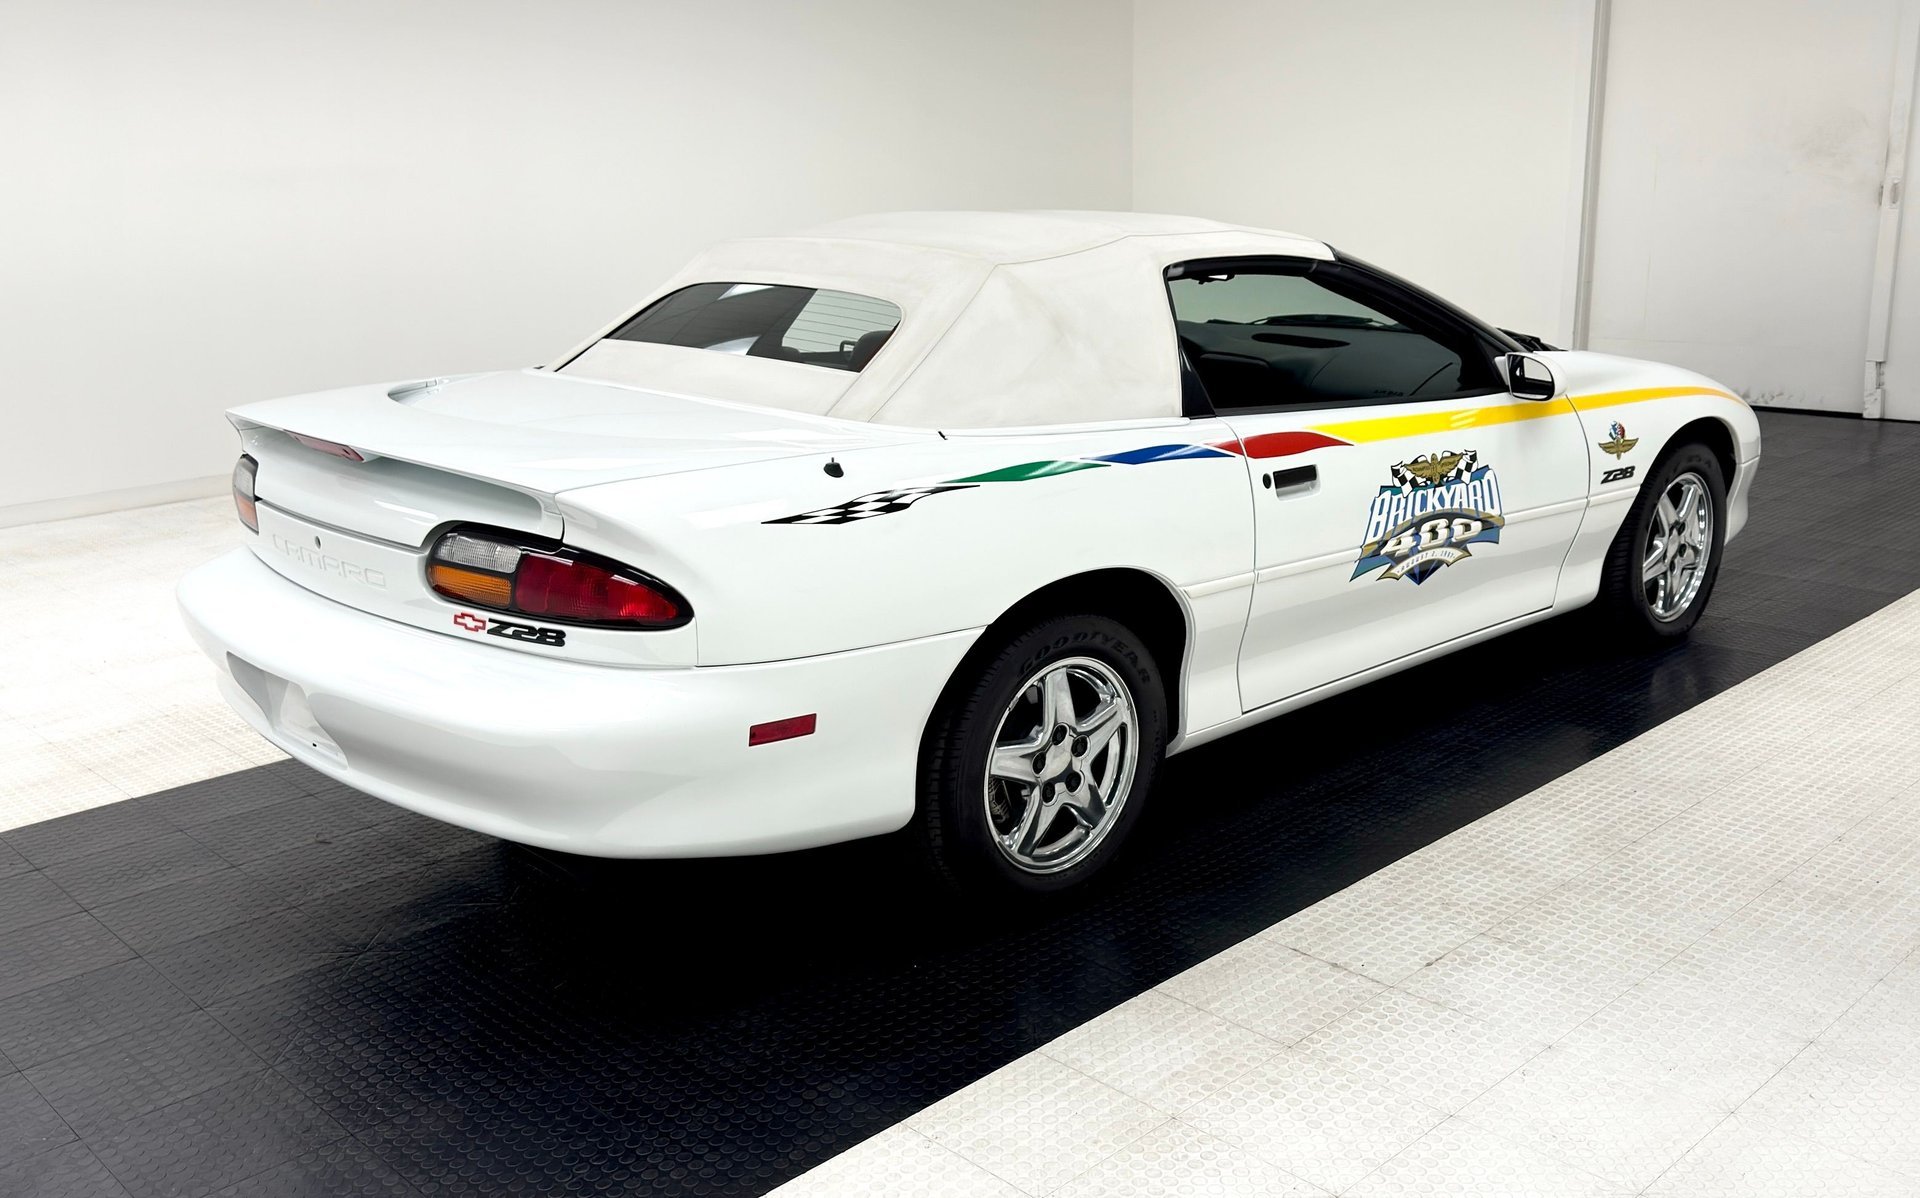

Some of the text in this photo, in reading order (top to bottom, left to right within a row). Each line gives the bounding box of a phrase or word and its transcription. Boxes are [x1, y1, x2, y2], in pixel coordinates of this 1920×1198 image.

[1600, 465, 1636, 485] Z28
[1364, 468, 1502, 546] BRICKYARD
[272, 533, 388, 591] CAMARO
[487, 617, 567, 648] Z28
[1017, 631, 1151, 684] GOODYEAR
